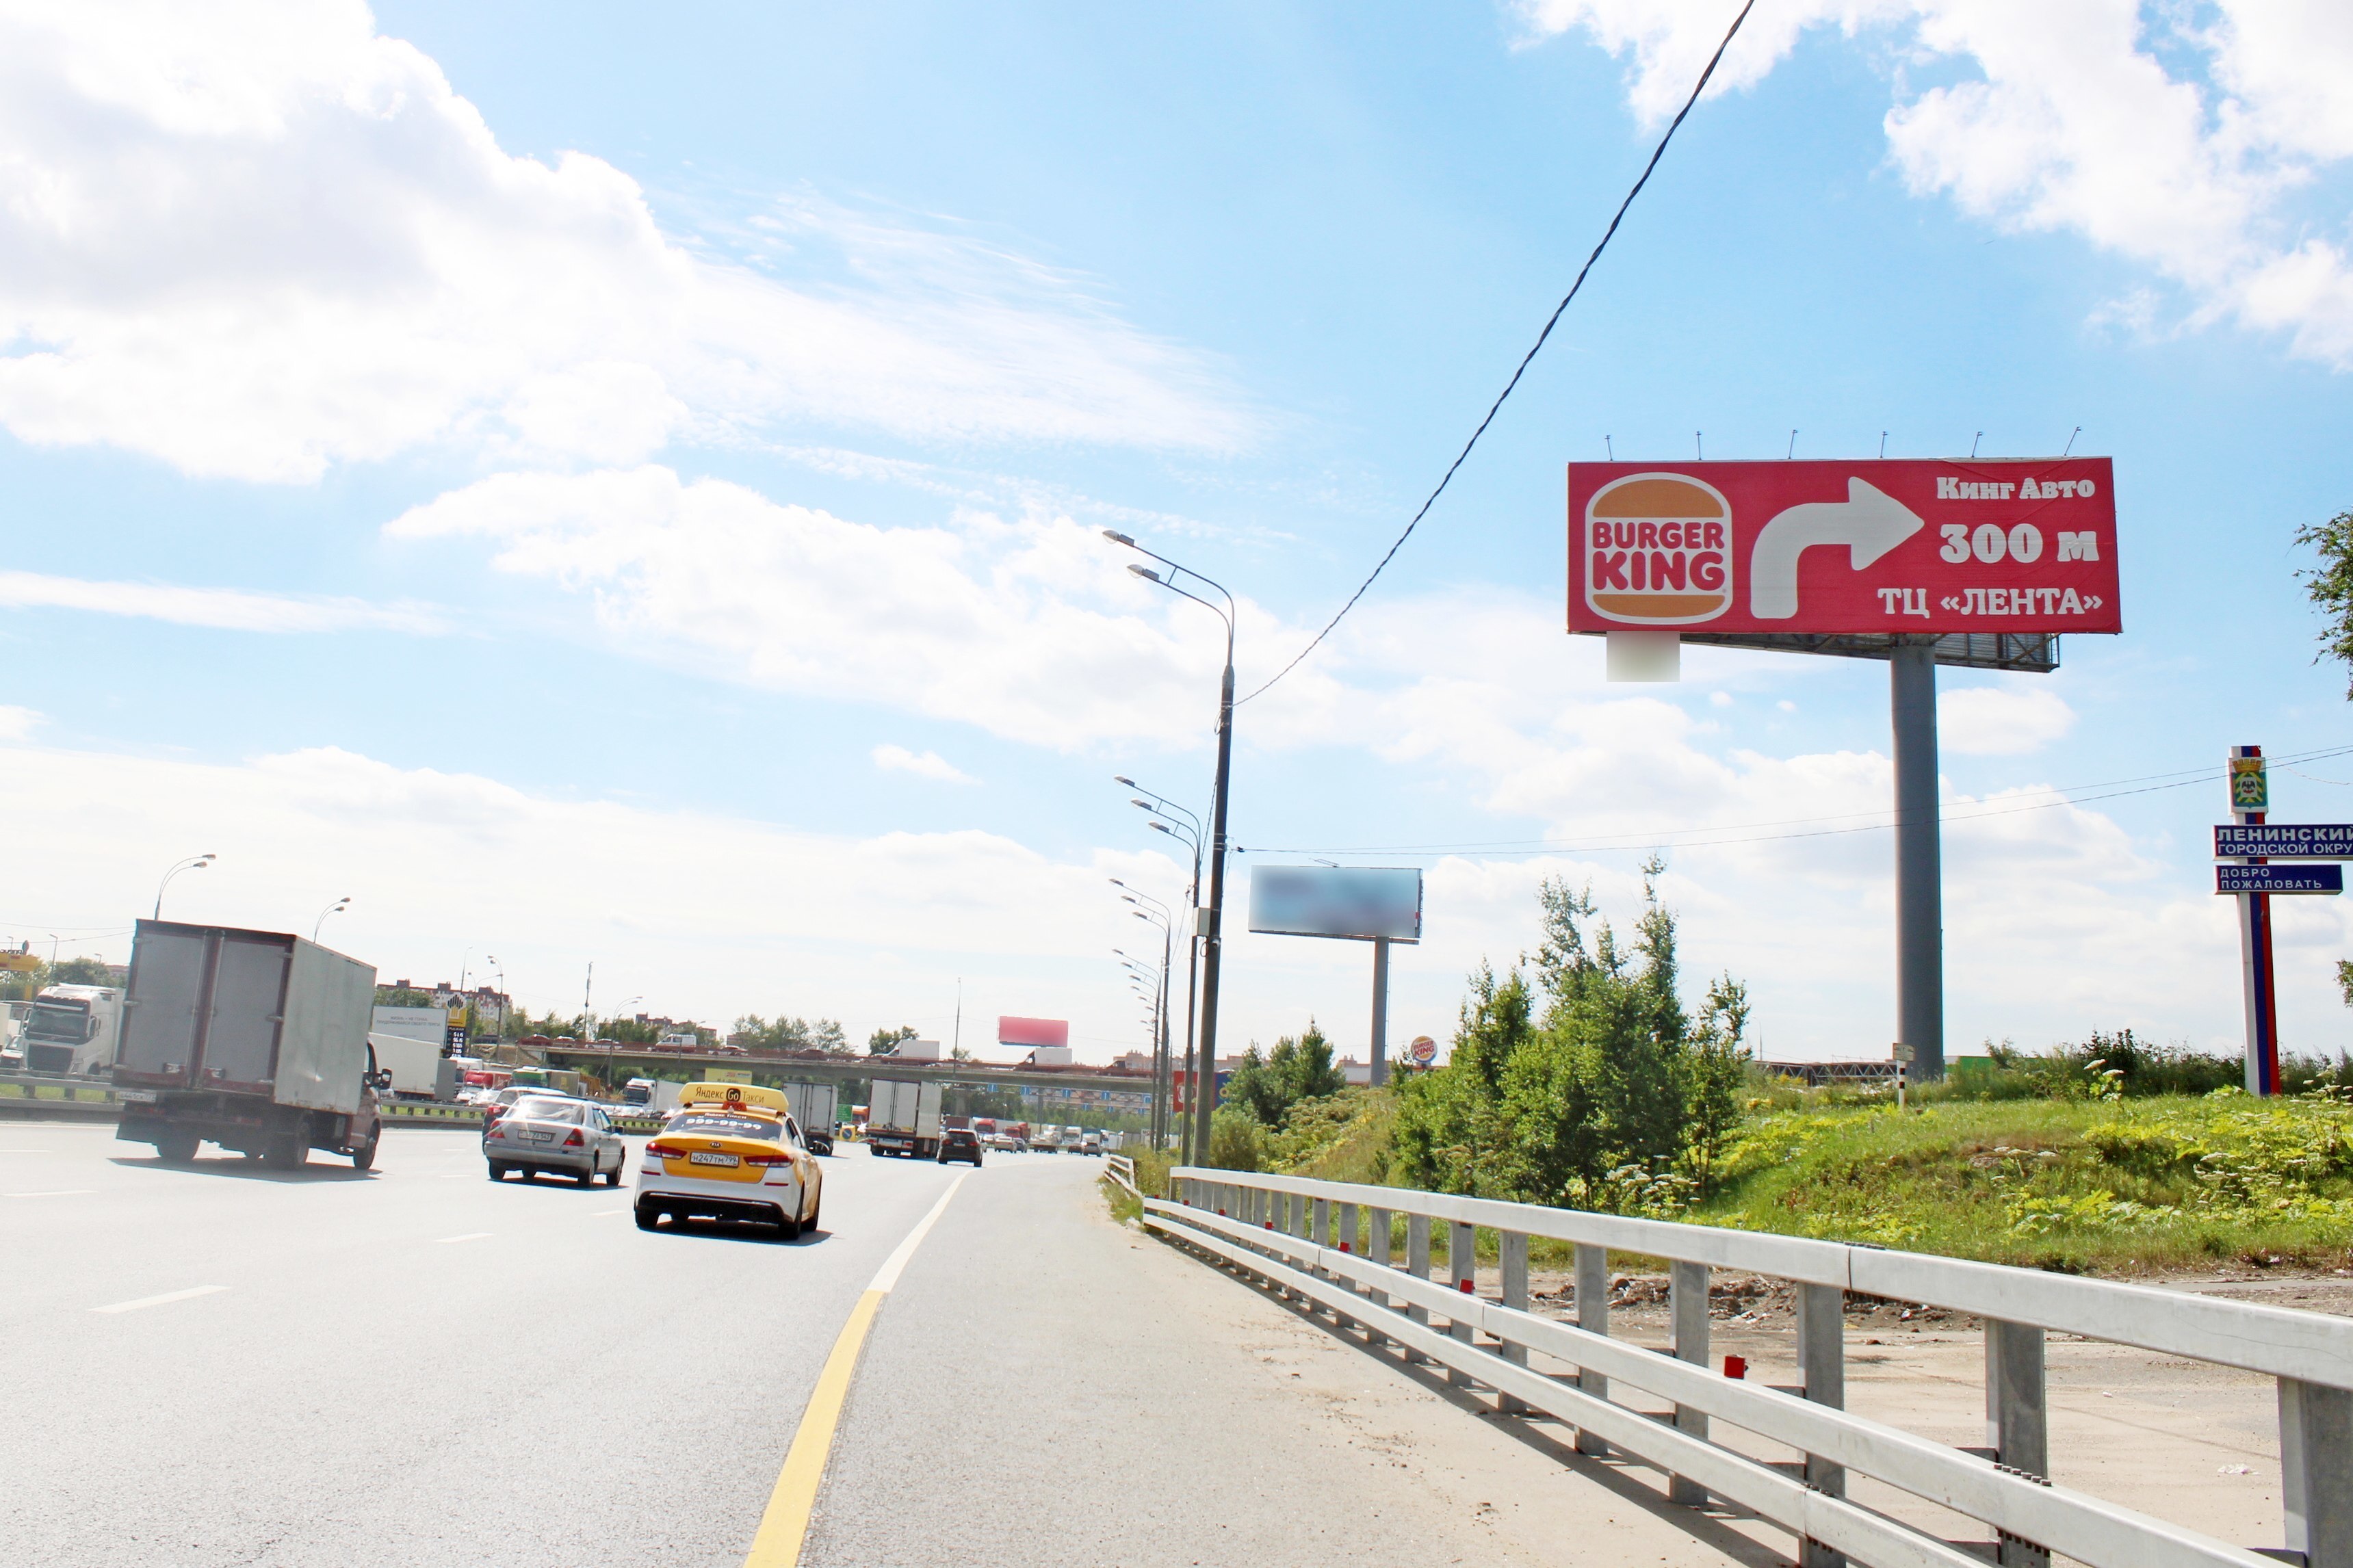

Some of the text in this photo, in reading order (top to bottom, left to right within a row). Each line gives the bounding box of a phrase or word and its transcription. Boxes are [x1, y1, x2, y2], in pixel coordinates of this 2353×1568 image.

[1936, 477, 2096, 499] Кинг Авто
[1592, 521, 1725, 549] BURGER
[1939, 523, 2100, 564] 300 м
[1592, 551, 1726, 591] KING
[1877, 587, 2103, 619] ТЦ «ЛЕНТА»
[2218, 841, 2309, 855] ГОРОДСКОЙ
[2220, 868, 2270, 878] ДОБРО
[2221, 880, 2322, 889] ПОЖАЛОВАТЬ
[1414, 1041, 1434, 1050] BURGER
[1414, 1045, 1434, 1056] KING
[695, 1086, 764, 1103] Яндекс Go Такси
[686, 1118, 762, 1130] 999-99-99
